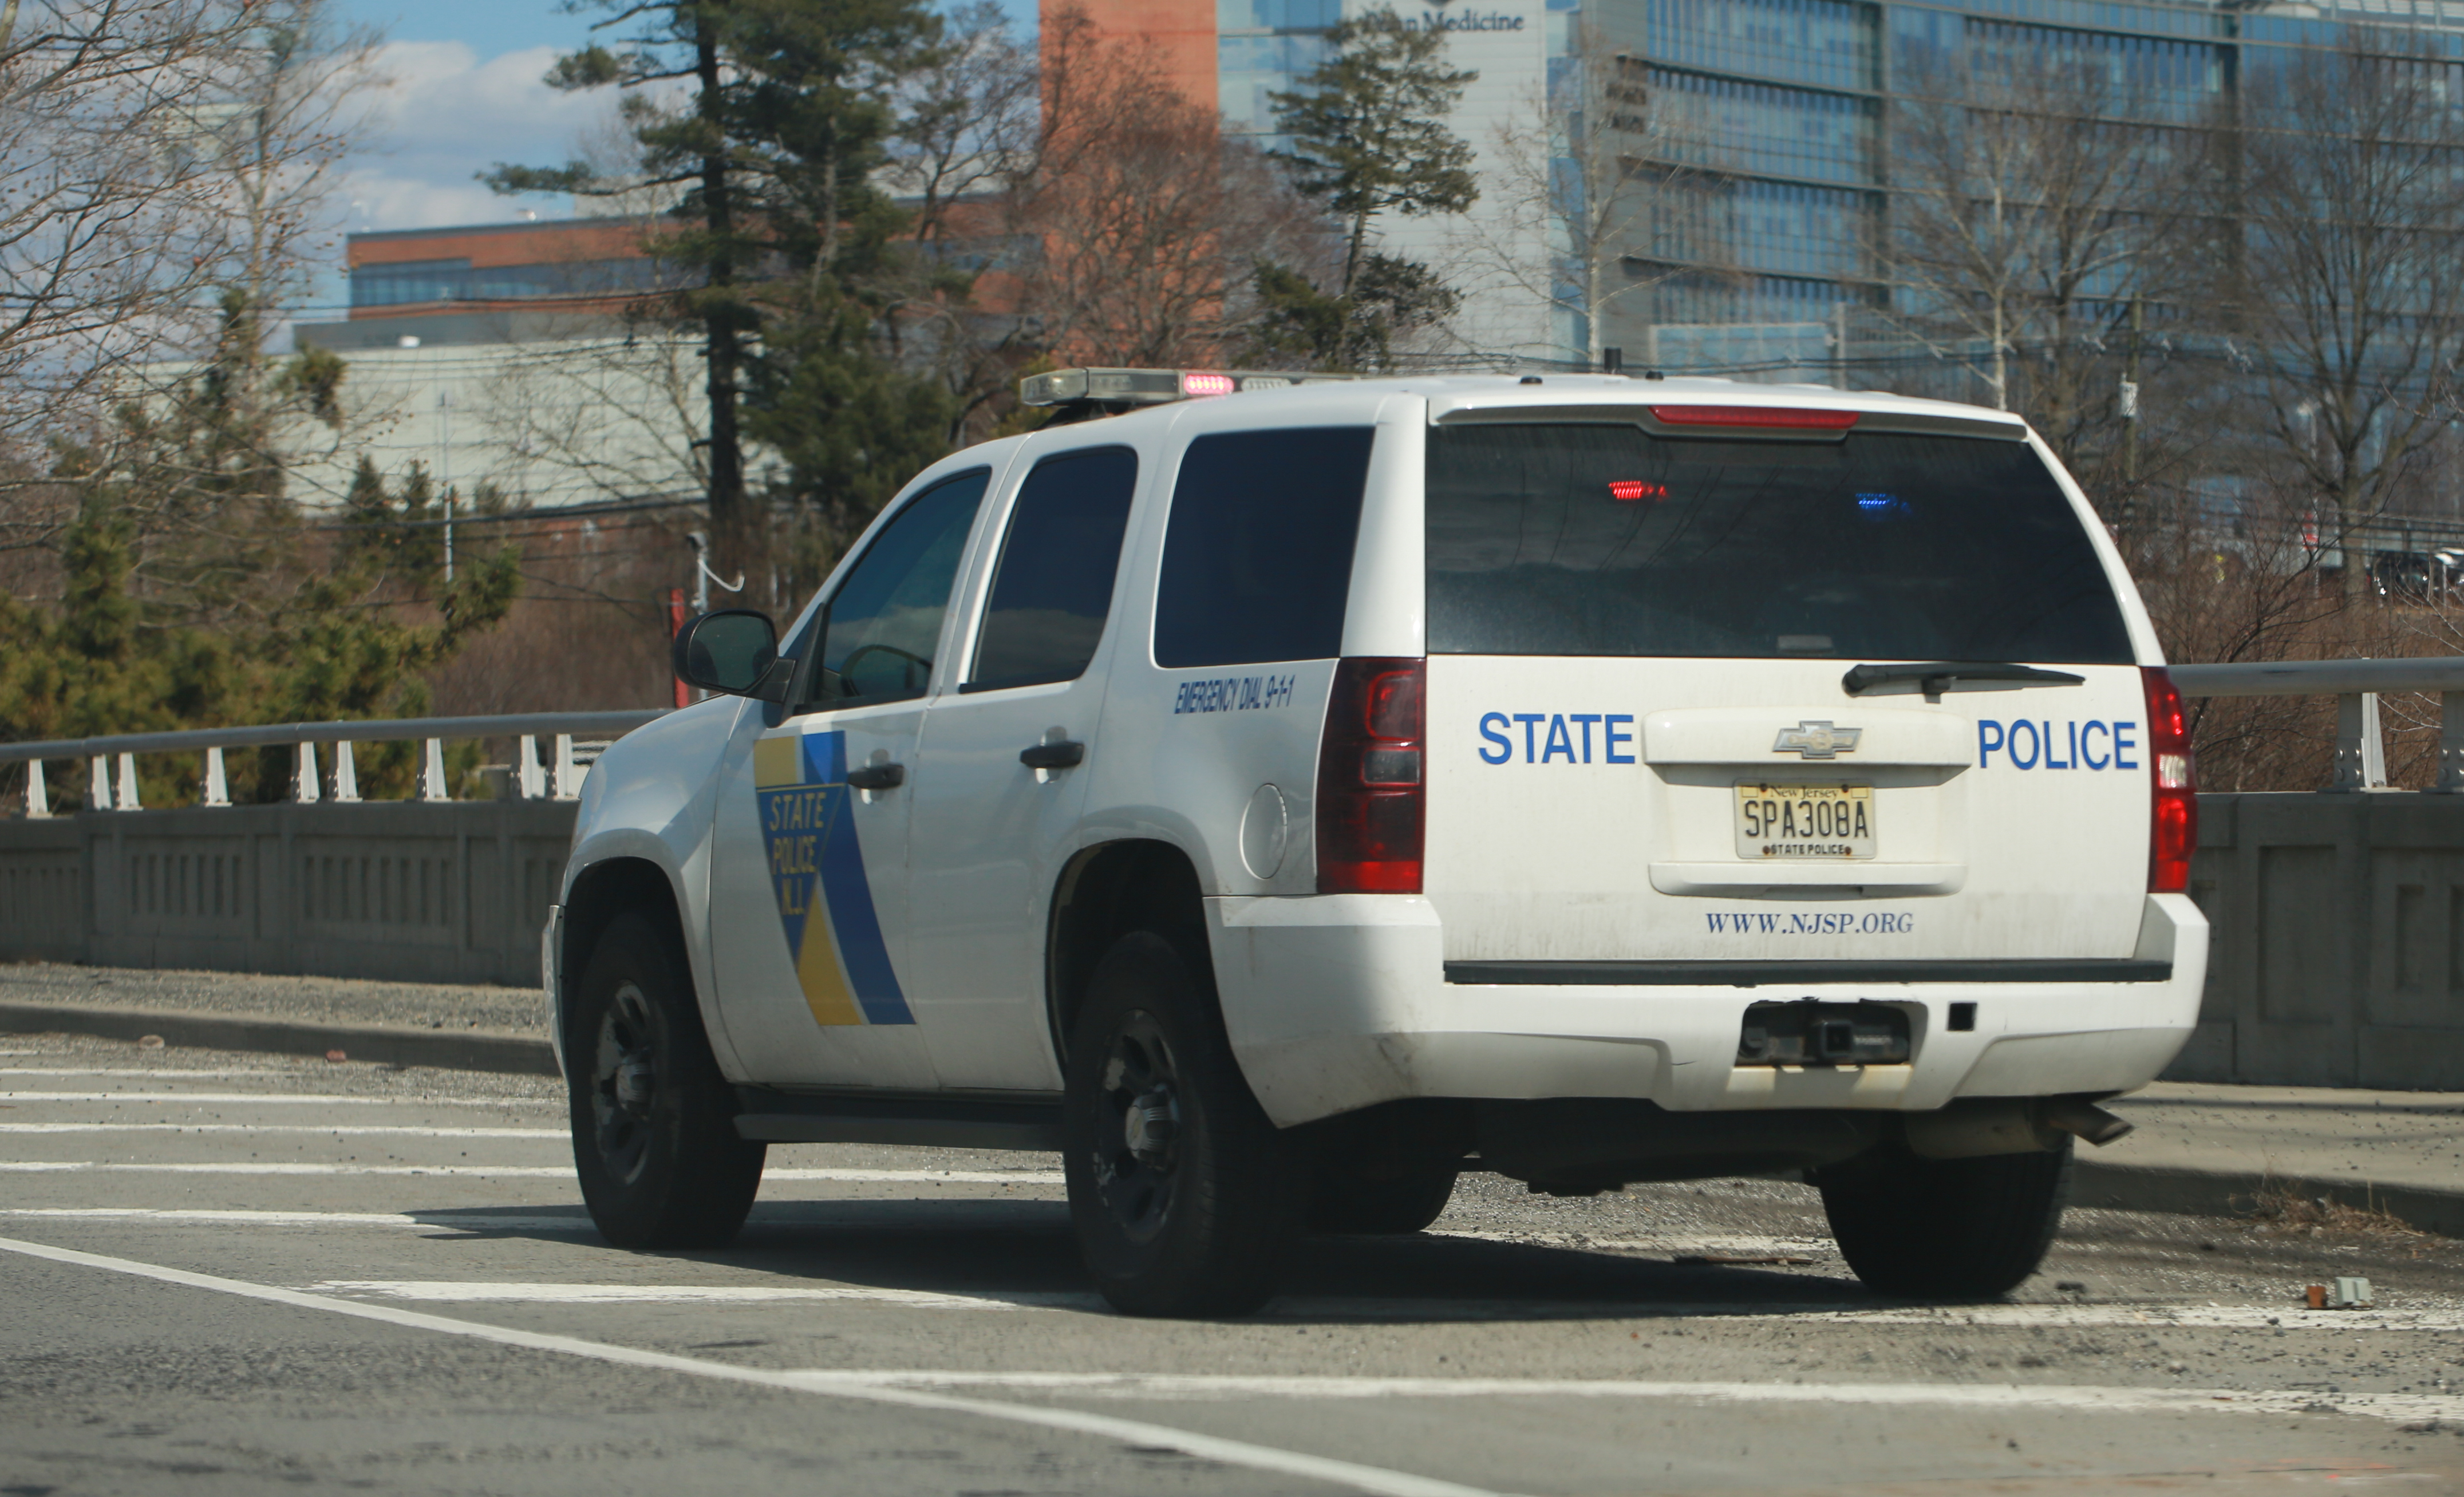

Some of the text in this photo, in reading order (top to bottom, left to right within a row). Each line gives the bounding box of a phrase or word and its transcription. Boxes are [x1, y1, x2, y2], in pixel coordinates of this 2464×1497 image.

[1422, 9, 1525, 31] Medicine
[1174, 674, 1296, 714] EMERGENCY DIAL 9-1-1
[1478, 712, 2138, 770] STATE POLICE
[769, 792, 827, 831] STATE
[1770, 785, 1839, 800] New Jersey
[1744, 800, 1868, 838] SPA308A
[772, 835, 817, 875] POLICE
[1770, 844, 1844, 855] STATE POLICE
[1705, 913, 1914, 934] WWW.NJSP.ORG
